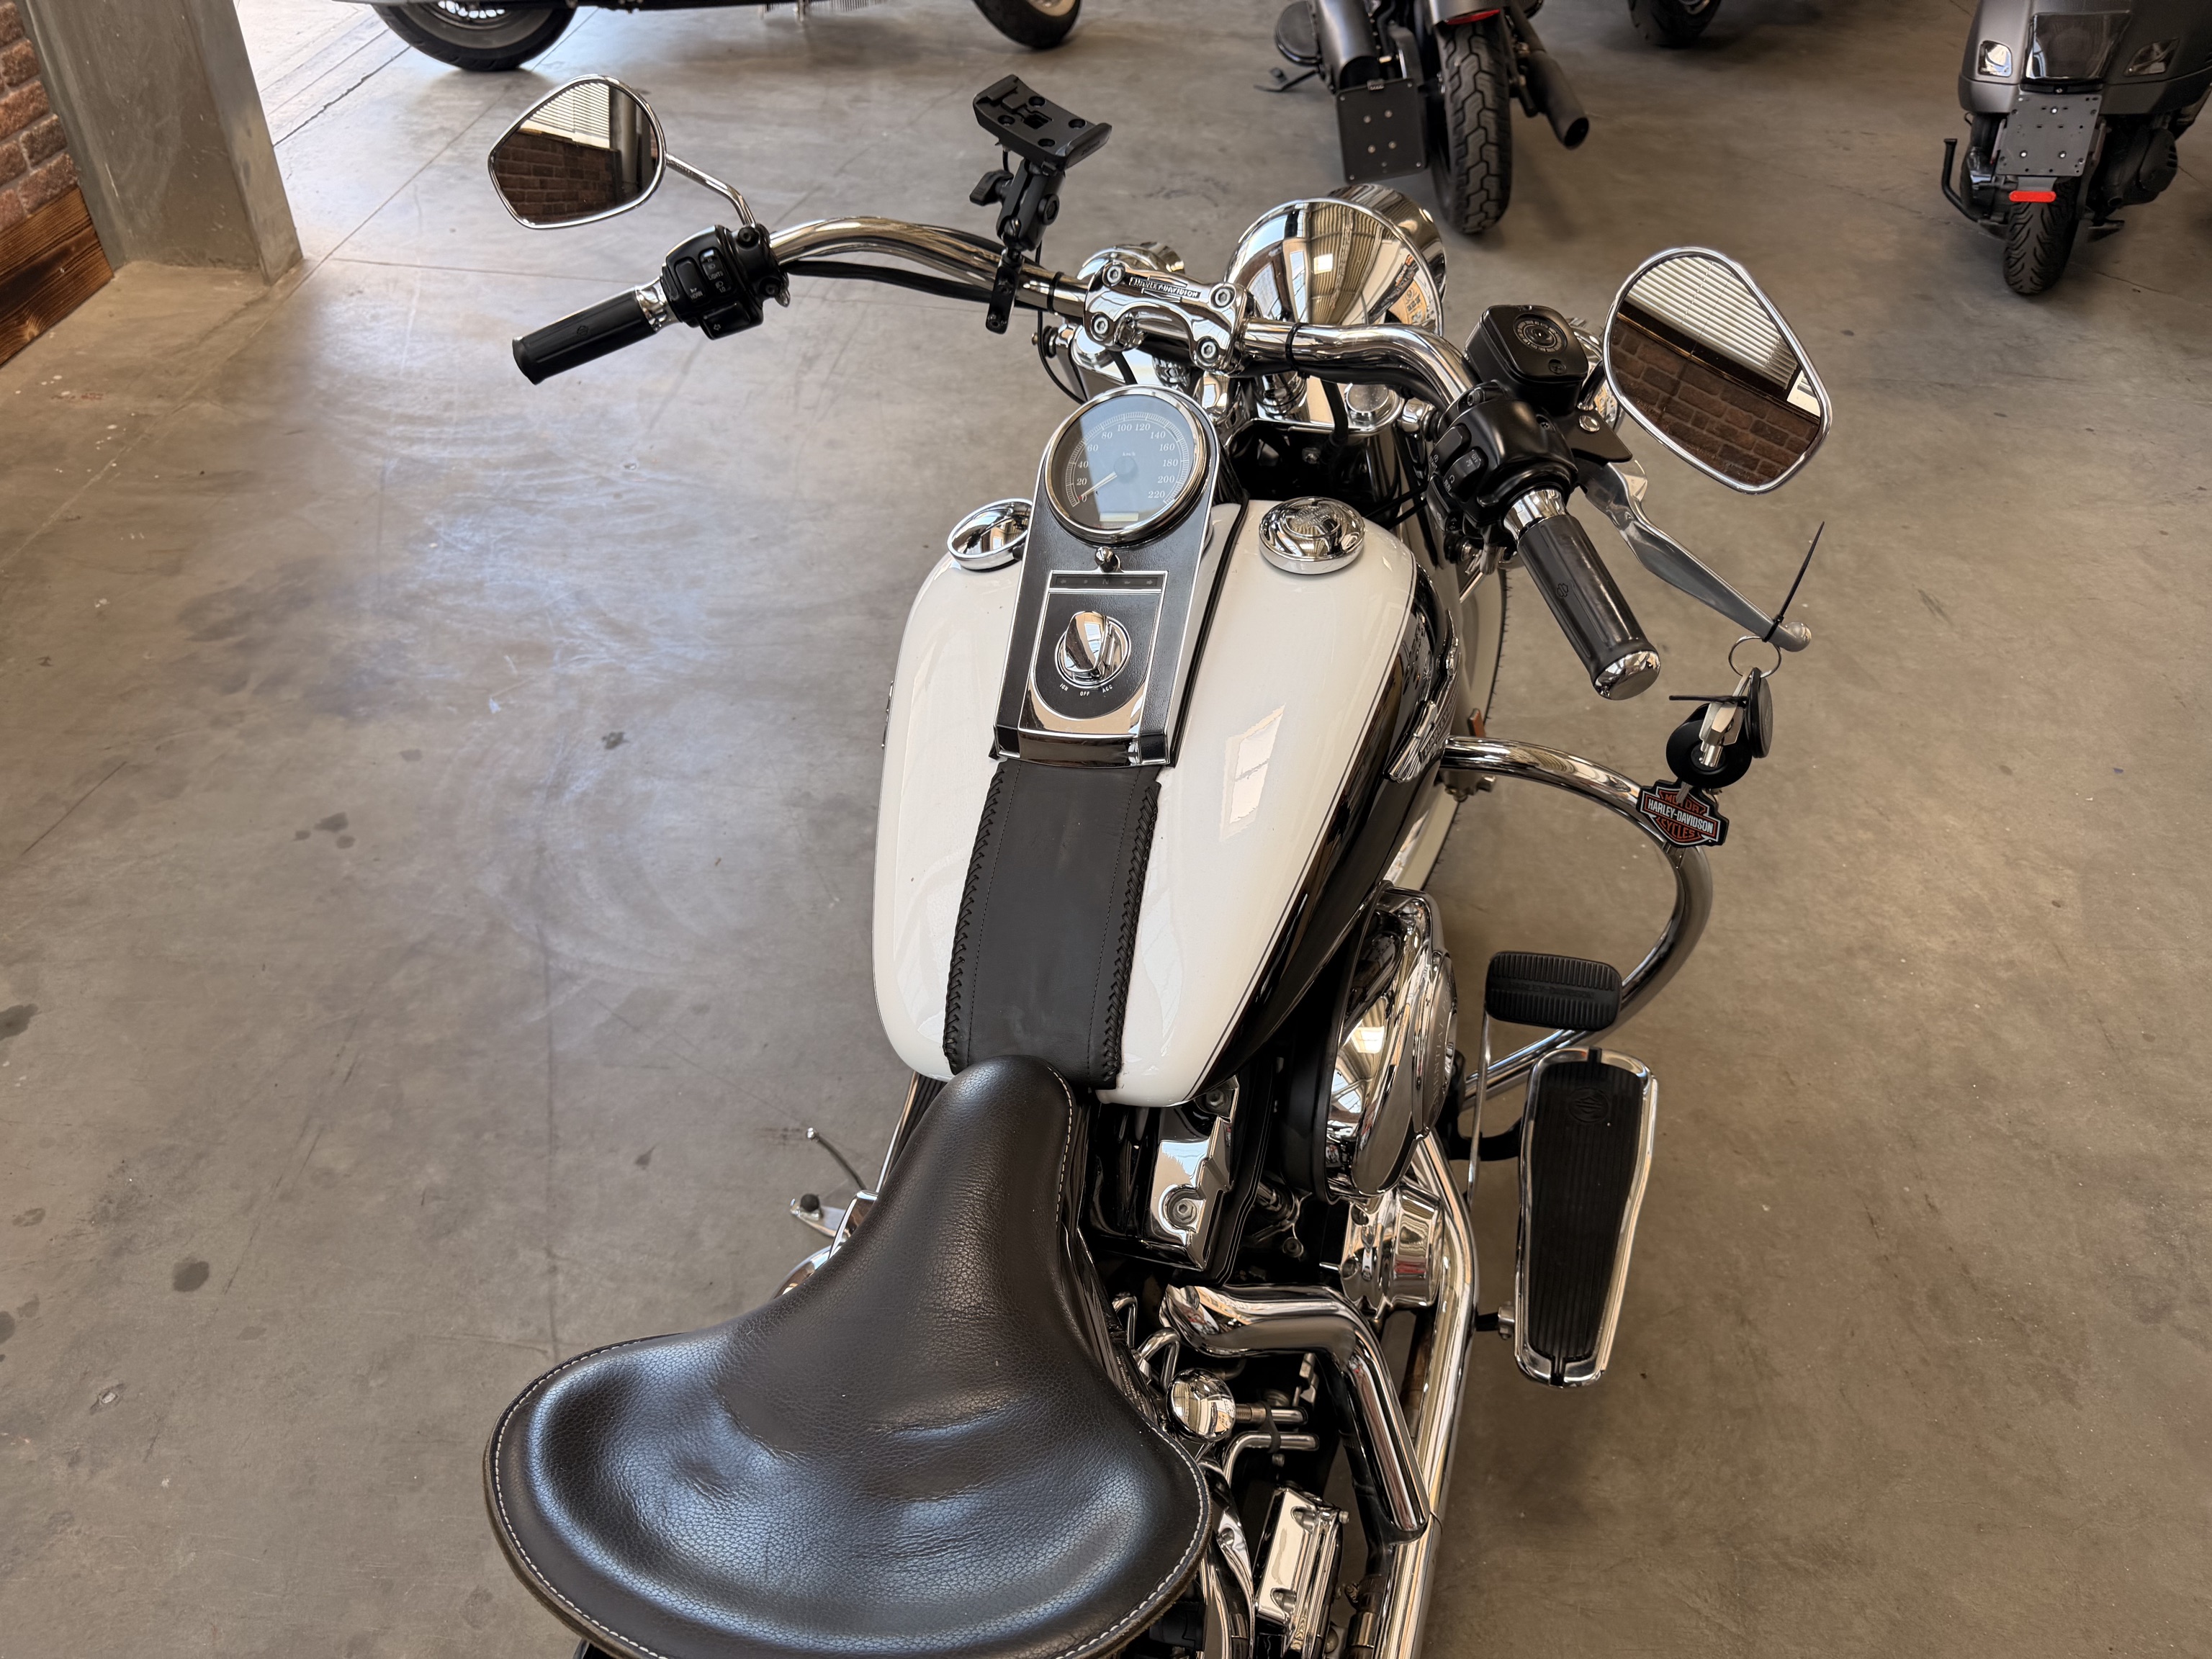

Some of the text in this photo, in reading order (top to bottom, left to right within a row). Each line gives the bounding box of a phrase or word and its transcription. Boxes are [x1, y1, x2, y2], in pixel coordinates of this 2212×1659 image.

[1077, 460, 1089, 469] 40
[1162, 459, 1179, 467] 180
[1076, 477, 1087, 486] 20
[1157, 475, 1175, 484] 200
[1148, 490, 1166, 499] 220
[1059, 683, 1069, 691] IGN
[1102, 684, 1113, 693] ACC
[1665, 793, 1700, 813] MOOR
[1647, 799, 1714, 834] HARLEY-DAVIDSON
[1661, 819, 1695, 839] CYCLES
